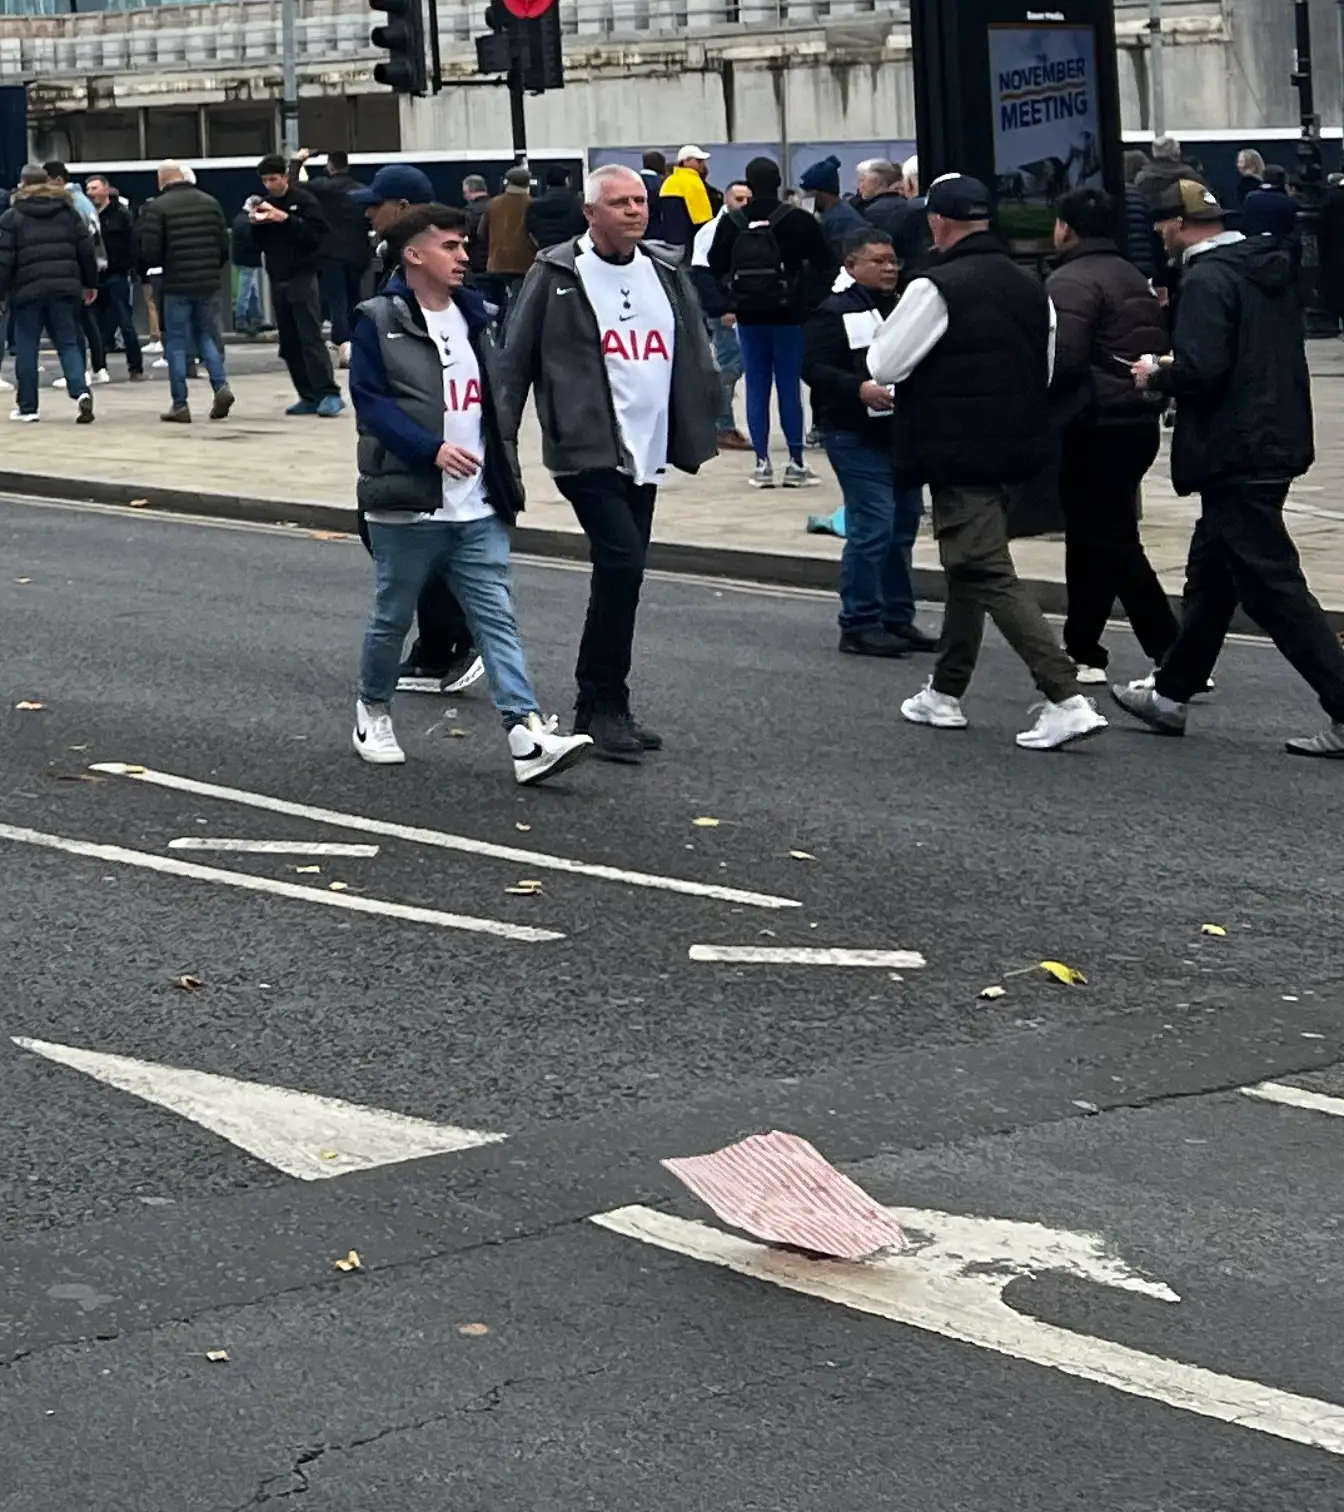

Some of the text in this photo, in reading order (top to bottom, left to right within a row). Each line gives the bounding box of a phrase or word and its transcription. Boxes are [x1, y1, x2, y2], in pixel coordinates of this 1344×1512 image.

[999, 57, 1086, 92] NOVEMBER
[1000, 90, 1089, 132] MEETING
[601, 328, 670, 362] AIA
[443, 377, 482, 412] IA
